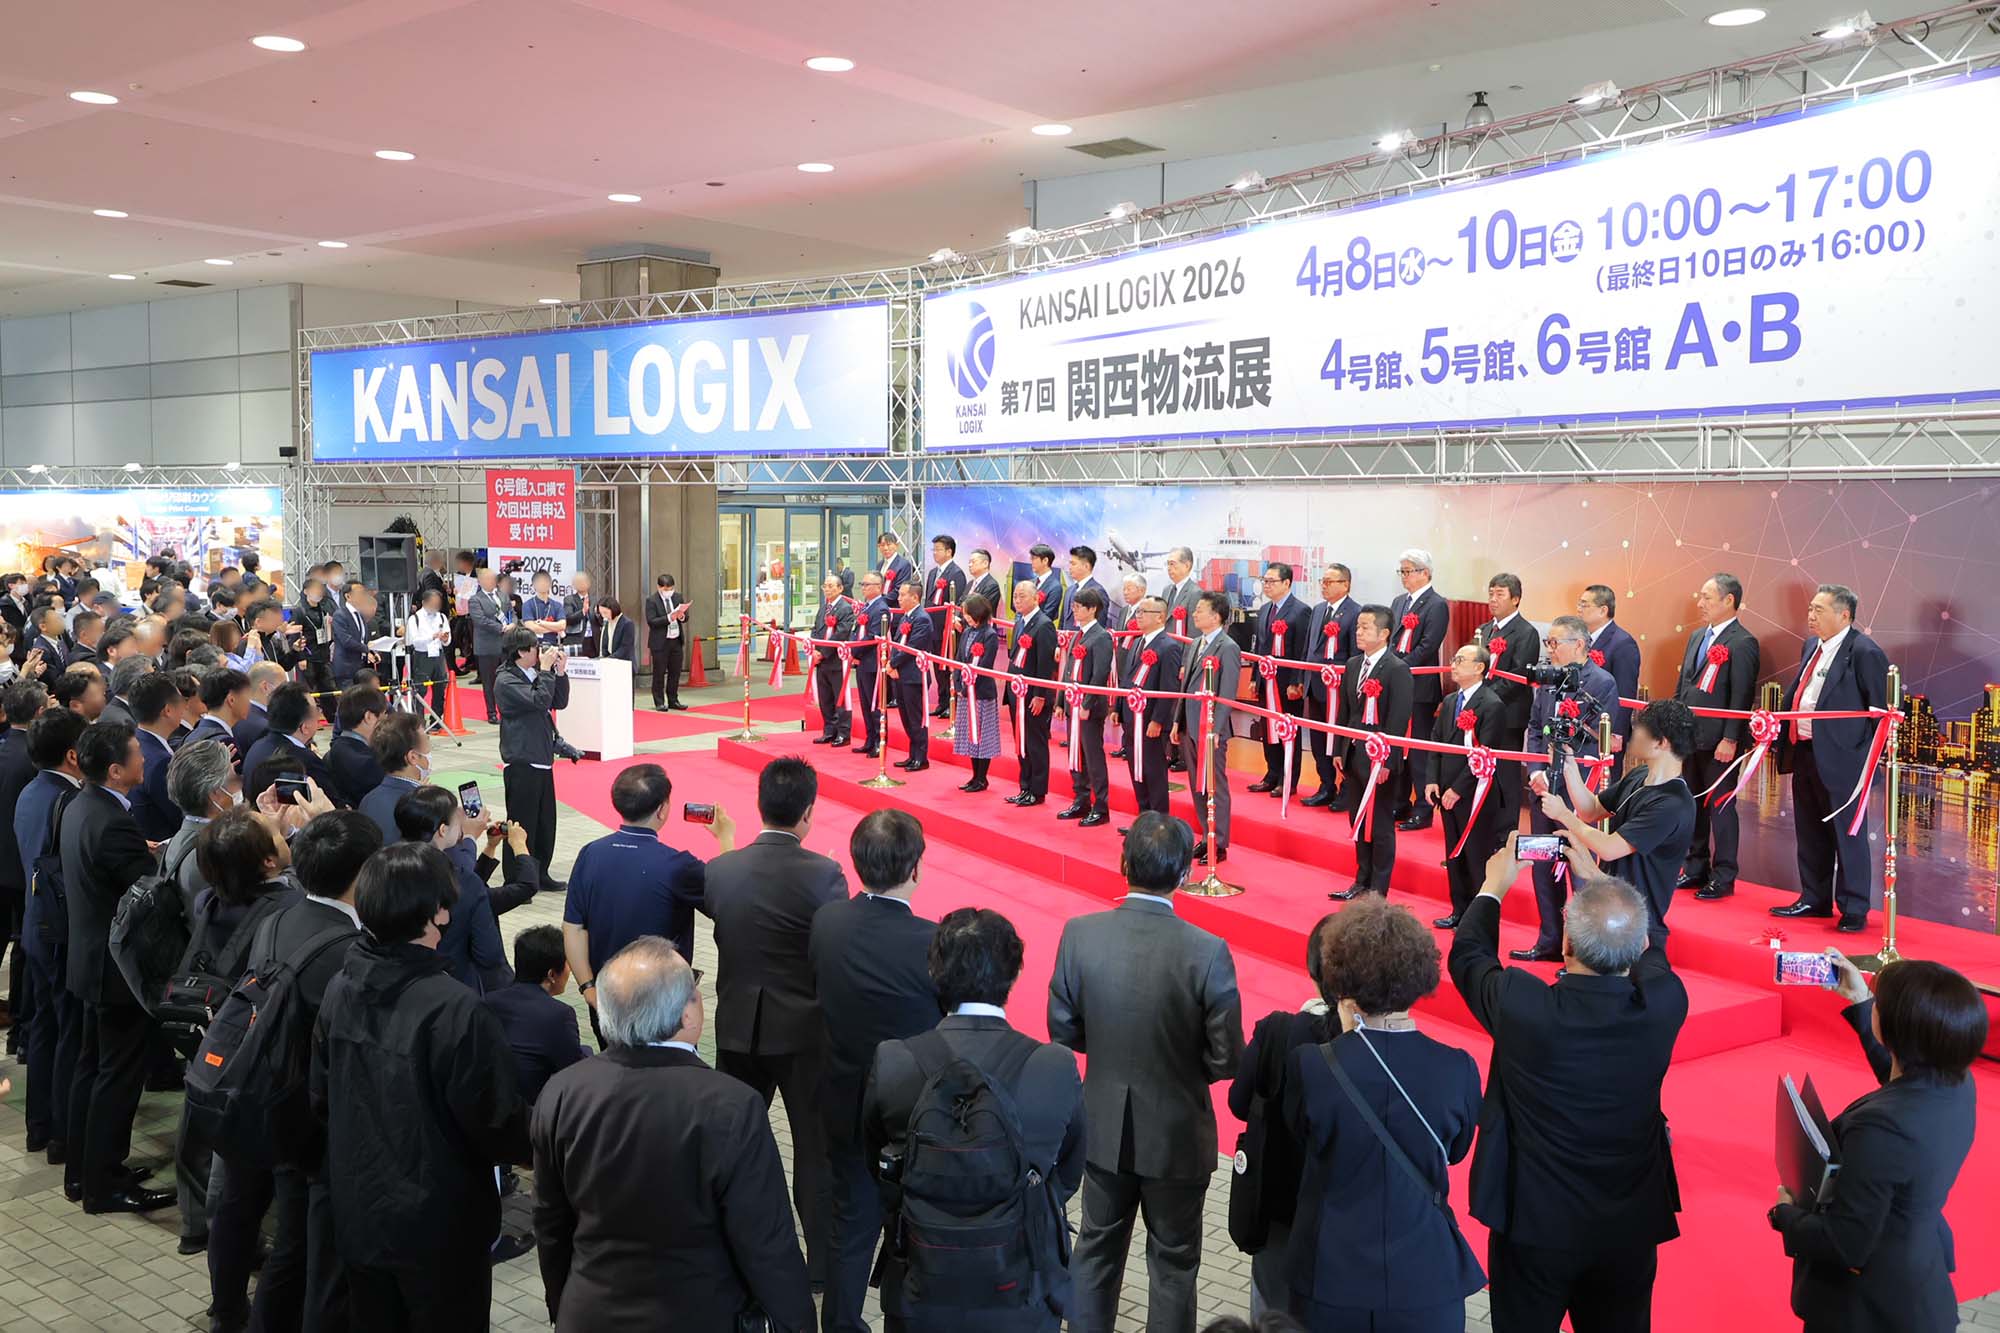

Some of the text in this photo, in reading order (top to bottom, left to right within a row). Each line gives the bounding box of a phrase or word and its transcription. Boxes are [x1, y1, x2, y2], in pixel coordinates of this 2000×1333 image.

[1020, 257, 1245, 329] KANSAI LOGIX 2026
[1001, 337, 1272, 421] 第7回 関西物流展
[353, 334, 813, 444] KANSAI LOGIX
[956, 403, 987, 418] KANSAI
[959, 419, 983, 434] LOGIX
[494, 478, 565, 497] 6号館入口横で
[496, 501, 566, 519] 次回出展申込
[523, 556, 561, 575] 2027年
